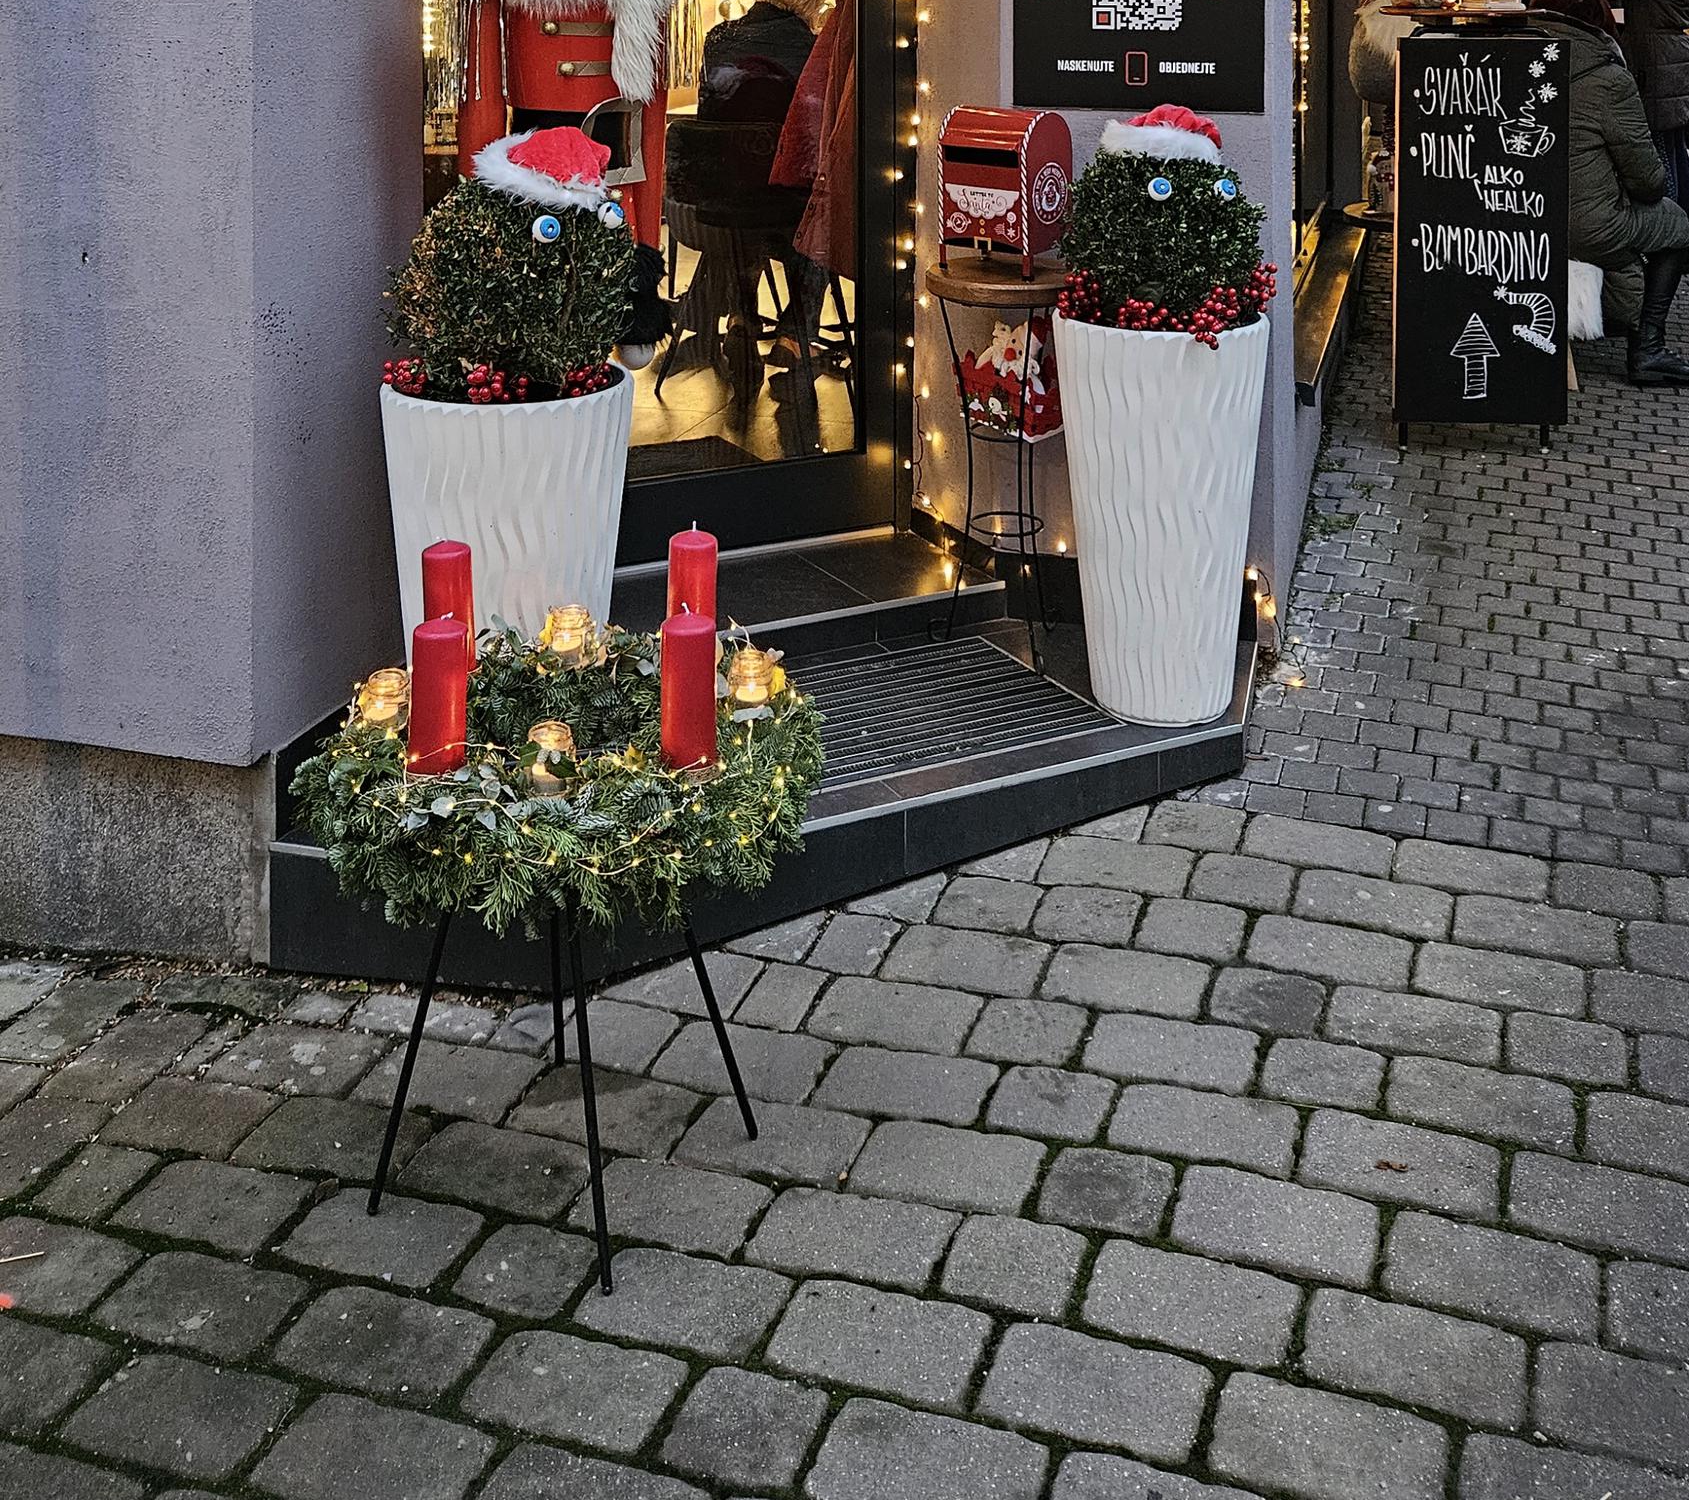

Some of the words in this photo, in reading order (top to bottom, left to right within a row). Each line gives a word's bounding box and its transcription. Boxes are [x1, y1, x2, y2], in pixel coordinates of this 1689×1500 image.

[1057, 59, 1115, 73] NASKENUJTE
[1158, 61, 1216, 75] OBJEDNEJTE
[1419, 52, 1508, 120] SVAŘÁK
[1420, 124, 1479, 179] PUNČ
[1483, 164, 1524, 188] ALKO
[1483, 188, 1545, 218] NEALKO
[1420, 222, 1550, 283] BOMBARDINO
